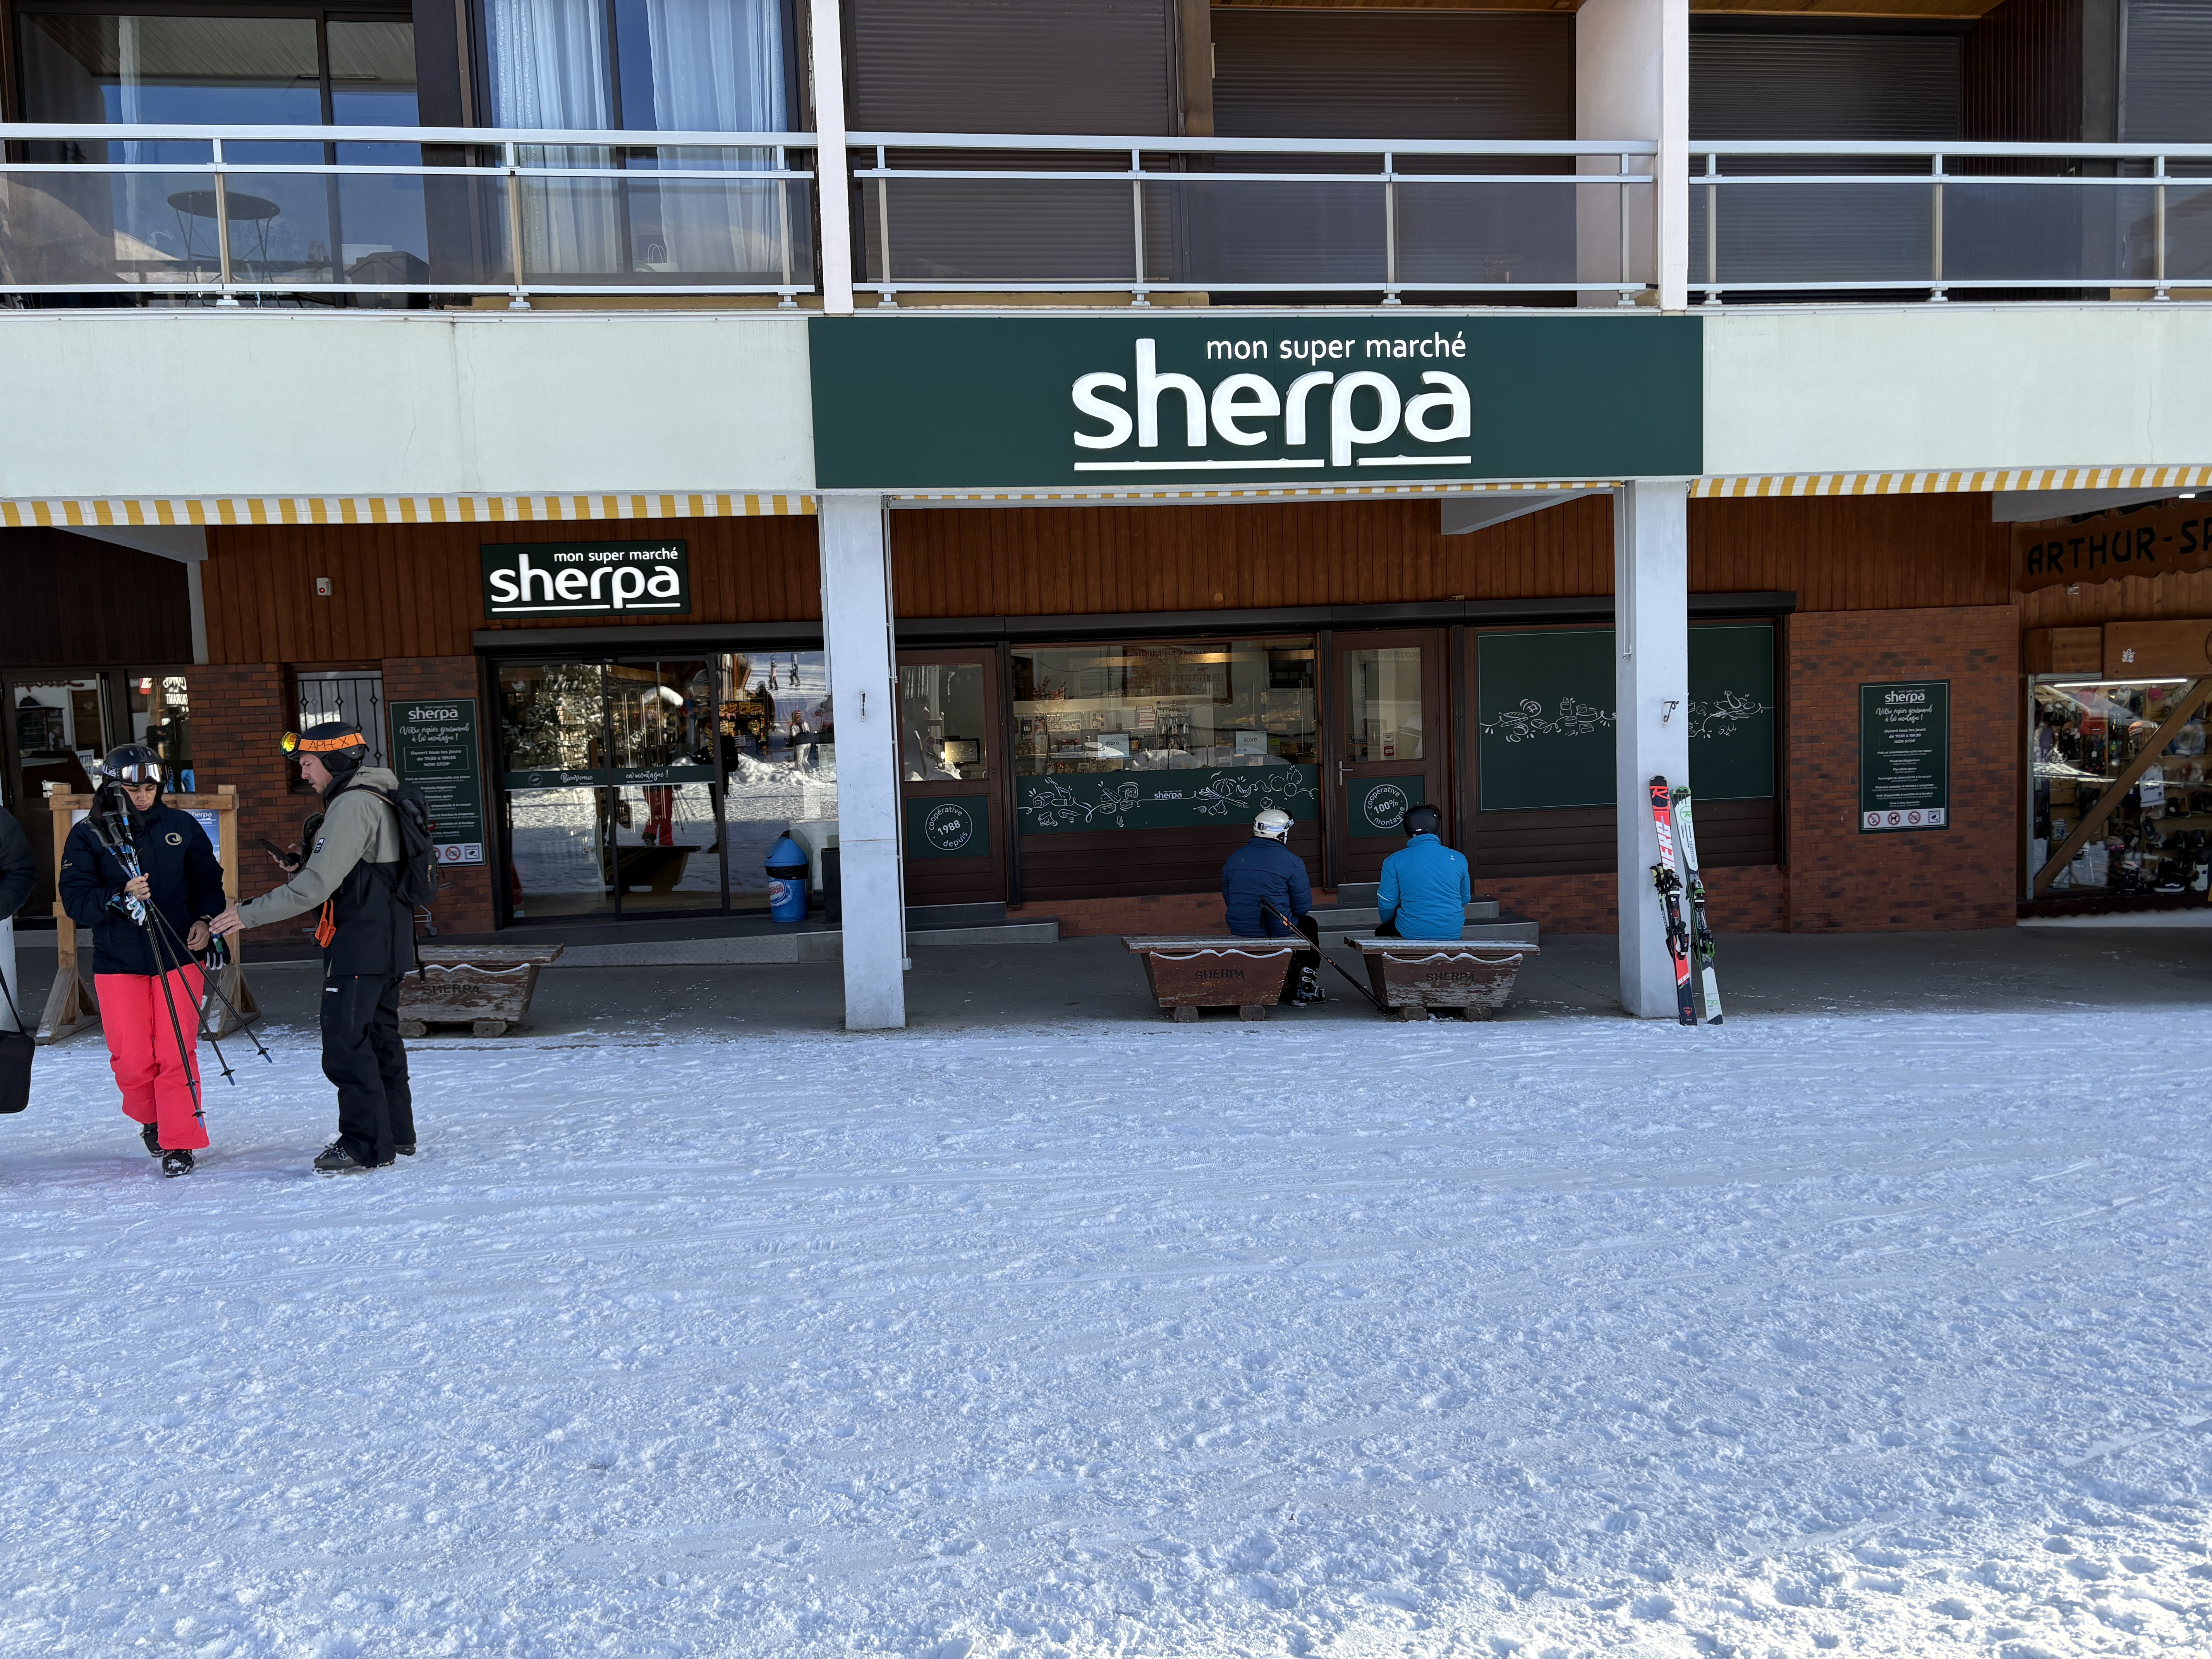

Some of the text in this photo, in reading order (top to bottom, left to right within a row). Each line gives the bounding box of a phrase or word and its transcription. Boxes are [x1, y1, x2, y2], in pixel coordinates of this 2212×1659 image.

[1207, 331, 1466, 366] mon super marché
[1072, 338, 1471, 466] sherpa
[554, 547, 678, 564] mon super marché
[489, 553, 680, 609] sherpa
[1885, 690, 1925, 703] sherpa
[409, 706, 458, 721] sherpa
[1154, 791, 1182, 799] sherpa
[1367, 787, 1400, 809] coopérative
[1374, 799, 1398, 814] 100%
[929, 806, 962, 830] coopérative
[1374, 807, 1405, 825] montagne
[938, 820, 960, 835] 1988
[943, 832, 967, 847] depuis
[1195, 969, 1245, 979] SHERPA
[1426, 972, 1474, 981] SHERPA
[423, 984, 479, 994] SHERPA
